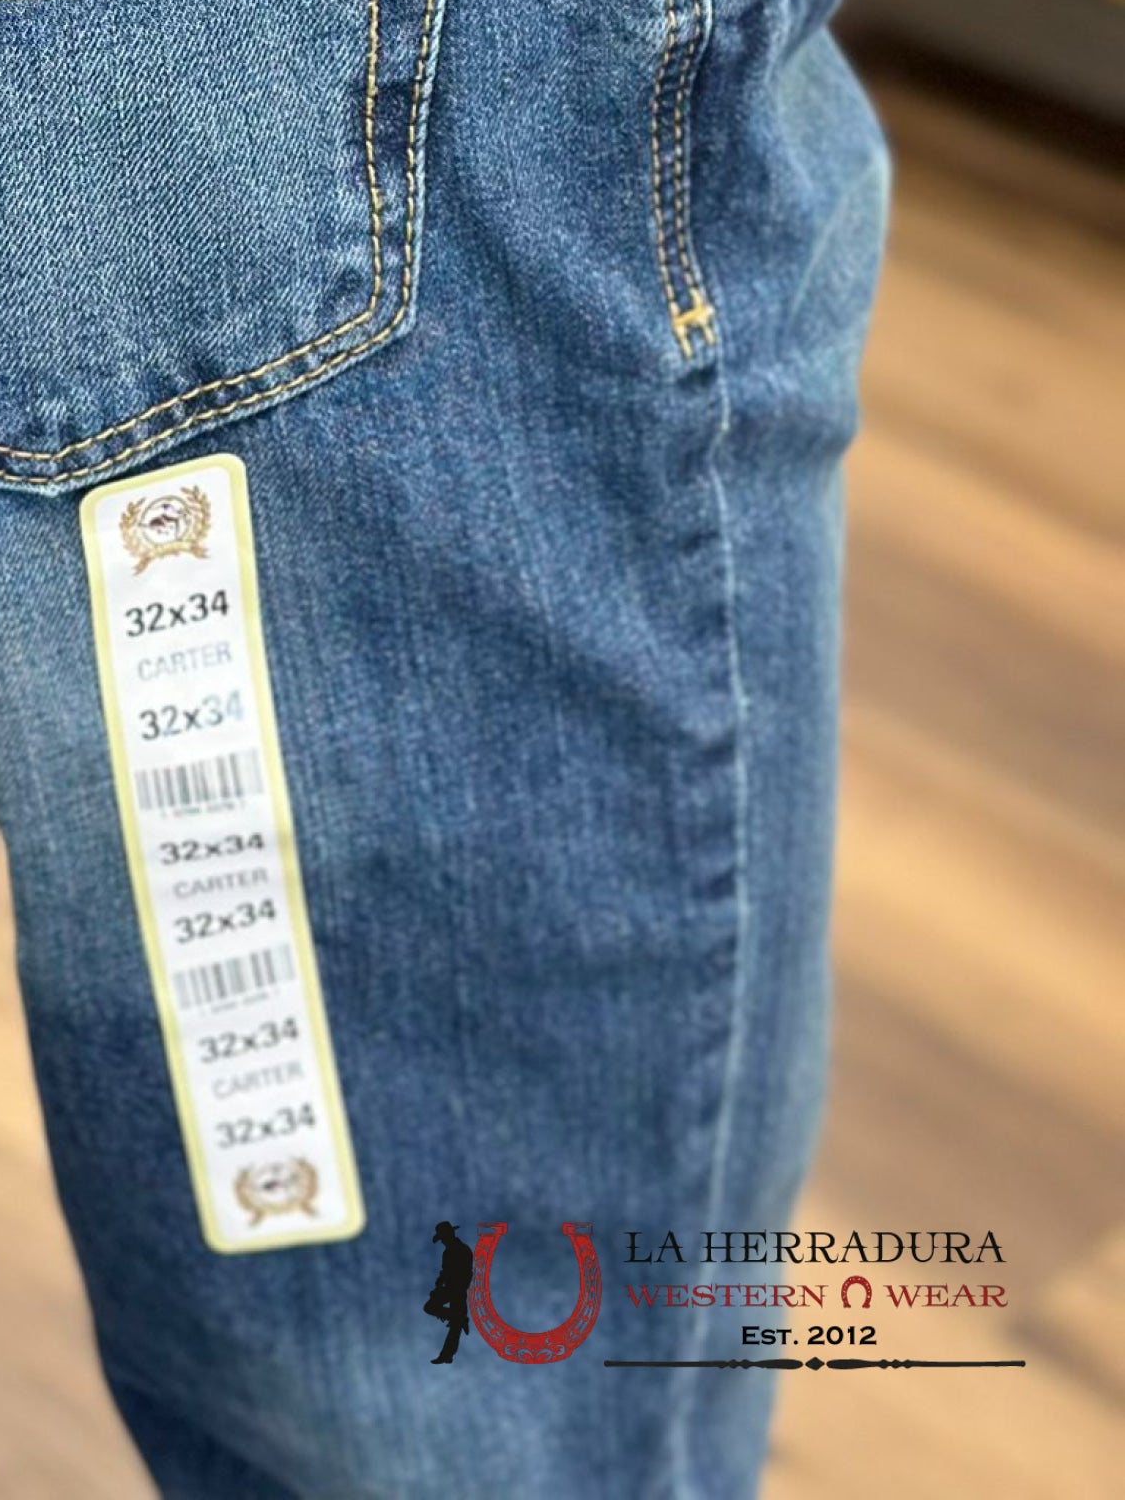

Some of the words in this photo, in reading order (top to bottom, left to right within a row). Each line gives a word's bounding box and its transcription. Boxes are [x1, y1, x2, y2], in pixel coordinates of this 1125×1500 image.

[125, 589, 231, 638] 32x34
[137, 642, 233, 681] CARTER
[139, 690, 245, 742] 32x34
[159, 832, 266, 866] 32x34
[173, 867, 269, 899] CARTER
[174, 898, 277, 944] 32x34
[198, 1017, 300, 1064] 32x34
[212, 1060, 305, 1101] CARTER
[215, 1103, 316, 1149] 32x34
